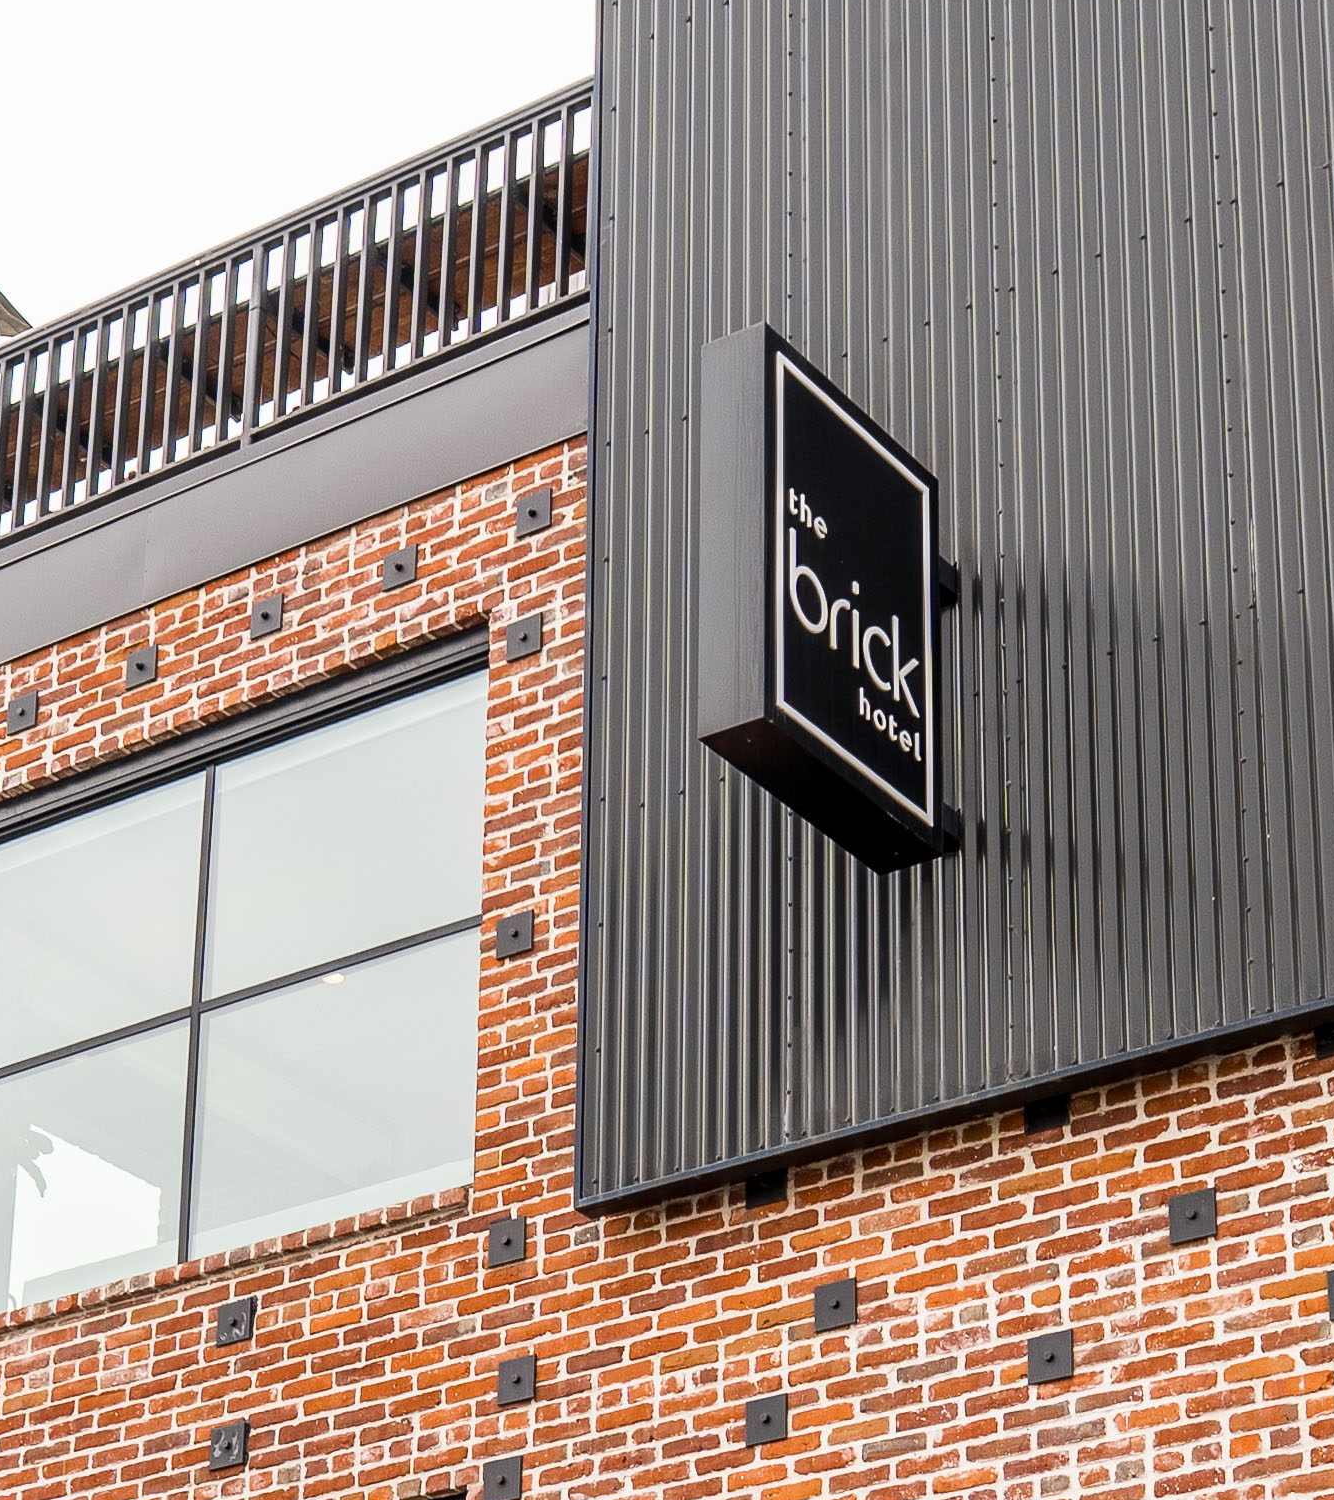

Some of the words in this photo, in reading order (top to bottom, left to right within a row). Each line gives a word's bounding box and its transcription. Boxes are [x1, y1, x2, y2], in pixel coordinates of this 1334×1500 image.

[788, 487, 828, 540] the
[788, 527, 920, 718] brick
[859, 687, 922, 762] hotel
